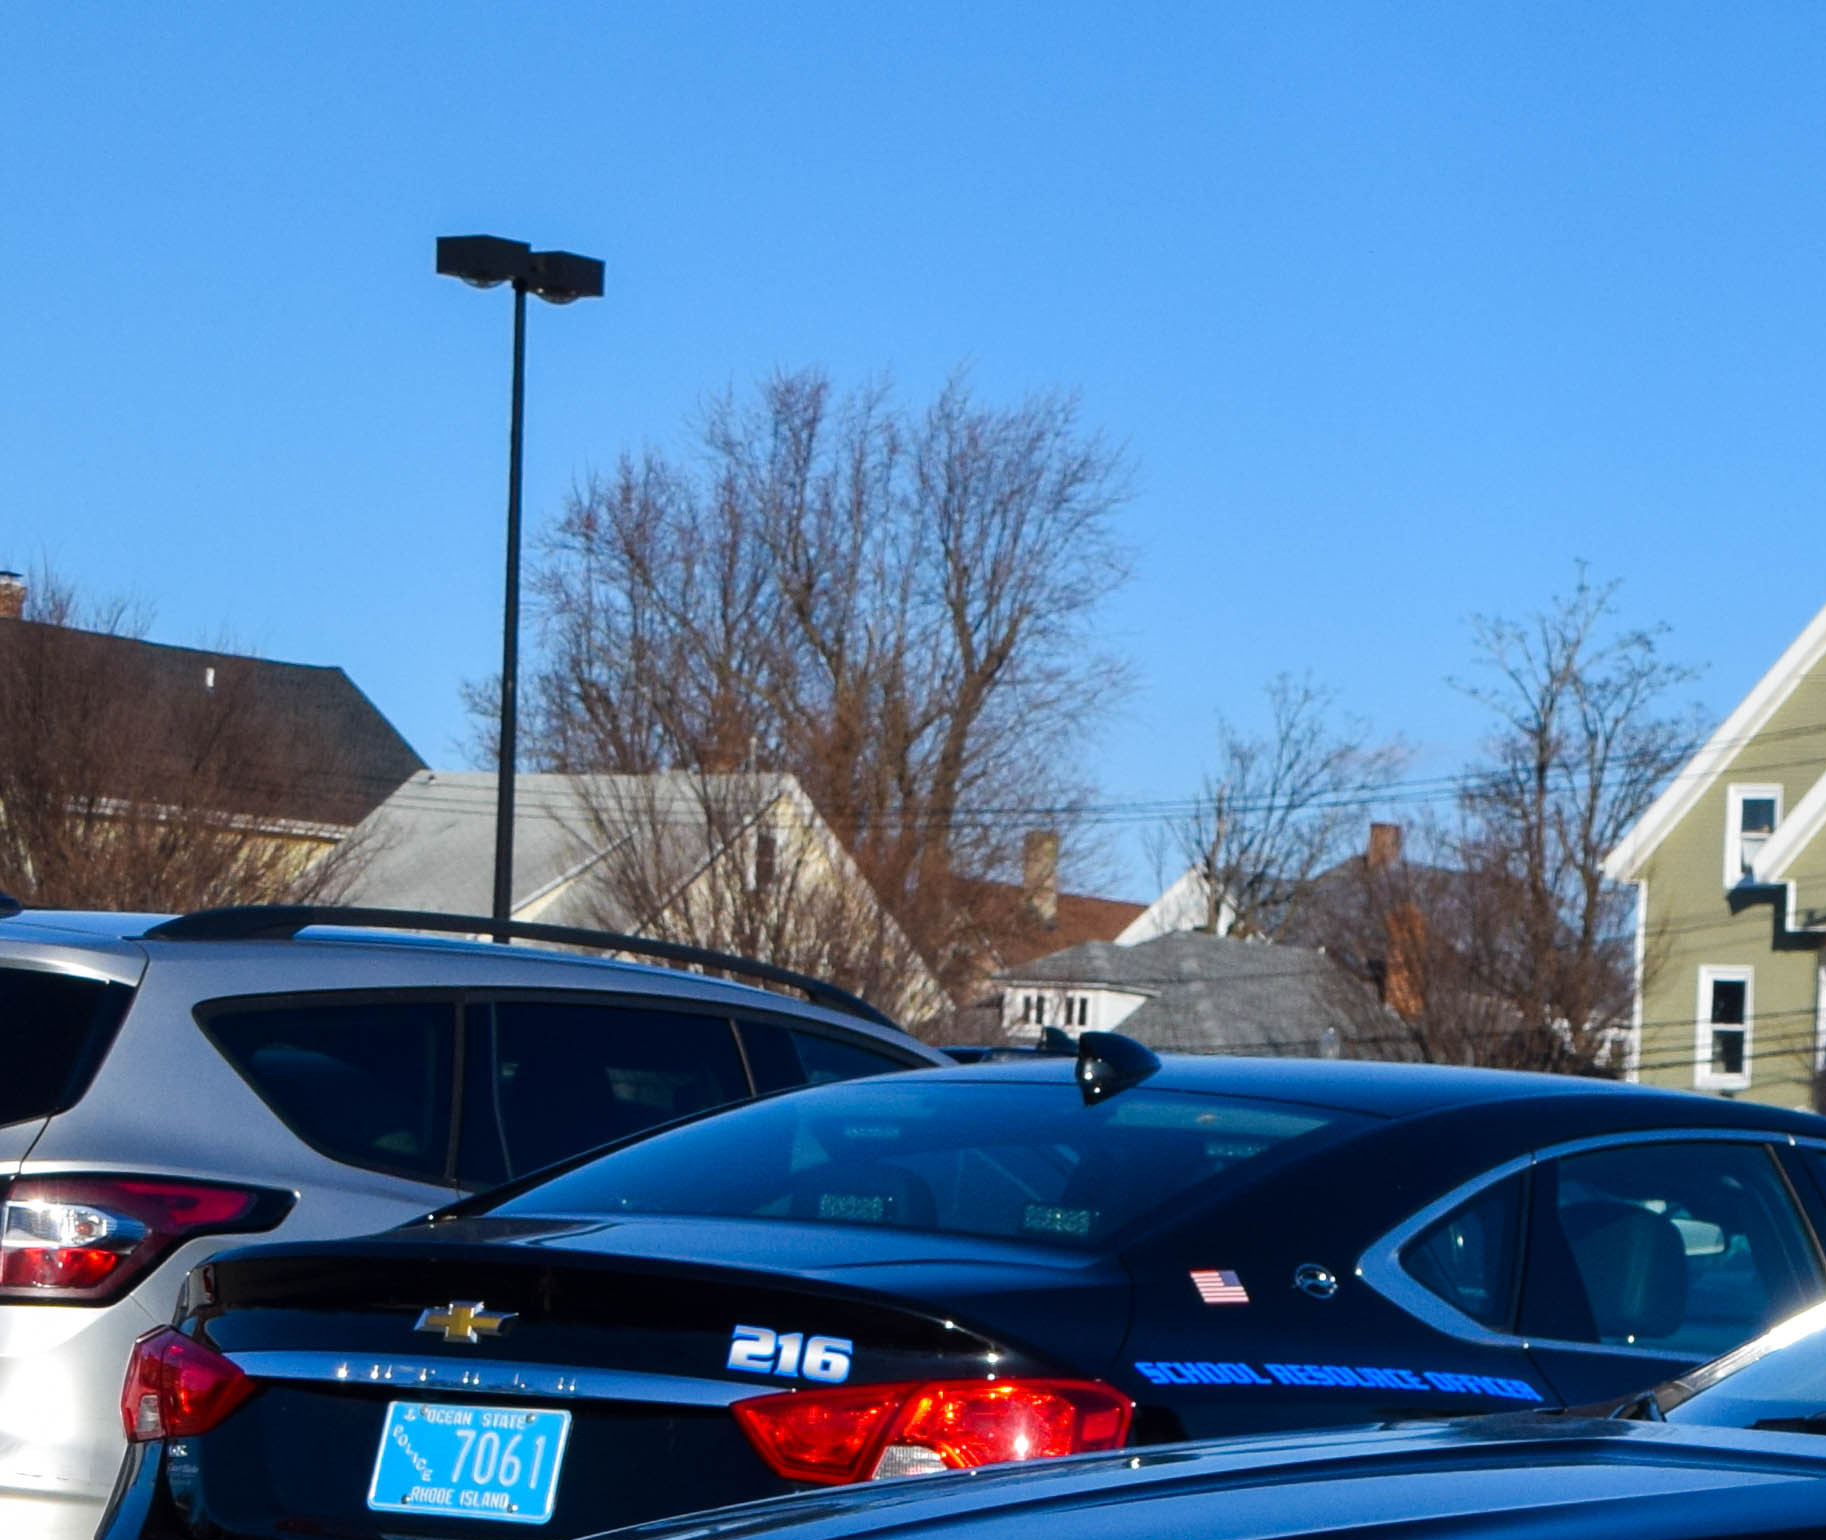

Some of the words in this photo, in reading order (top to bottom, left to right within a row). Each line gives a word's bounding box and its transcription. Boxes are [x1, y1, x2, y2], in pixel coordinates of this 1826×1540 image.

[727, 1325, 853, 1384] 216
[1134, 1362, 1272, 1384] SCHOOL
[1264, 1363, 1430, 1391] RESOURCE
[1424, 1371, 1544, 1402] OFFICER
[427, 1409, 472, 1425] OCEAN
[481, 1412, 527, 1430] STATE
[392, 1424, 434, 1481] POLICE
[451, 1428, 547, 1490] 7061
[410, 1485, 455, 1505] RHODE
[460, 1490, 510, 1510] ISLAND
